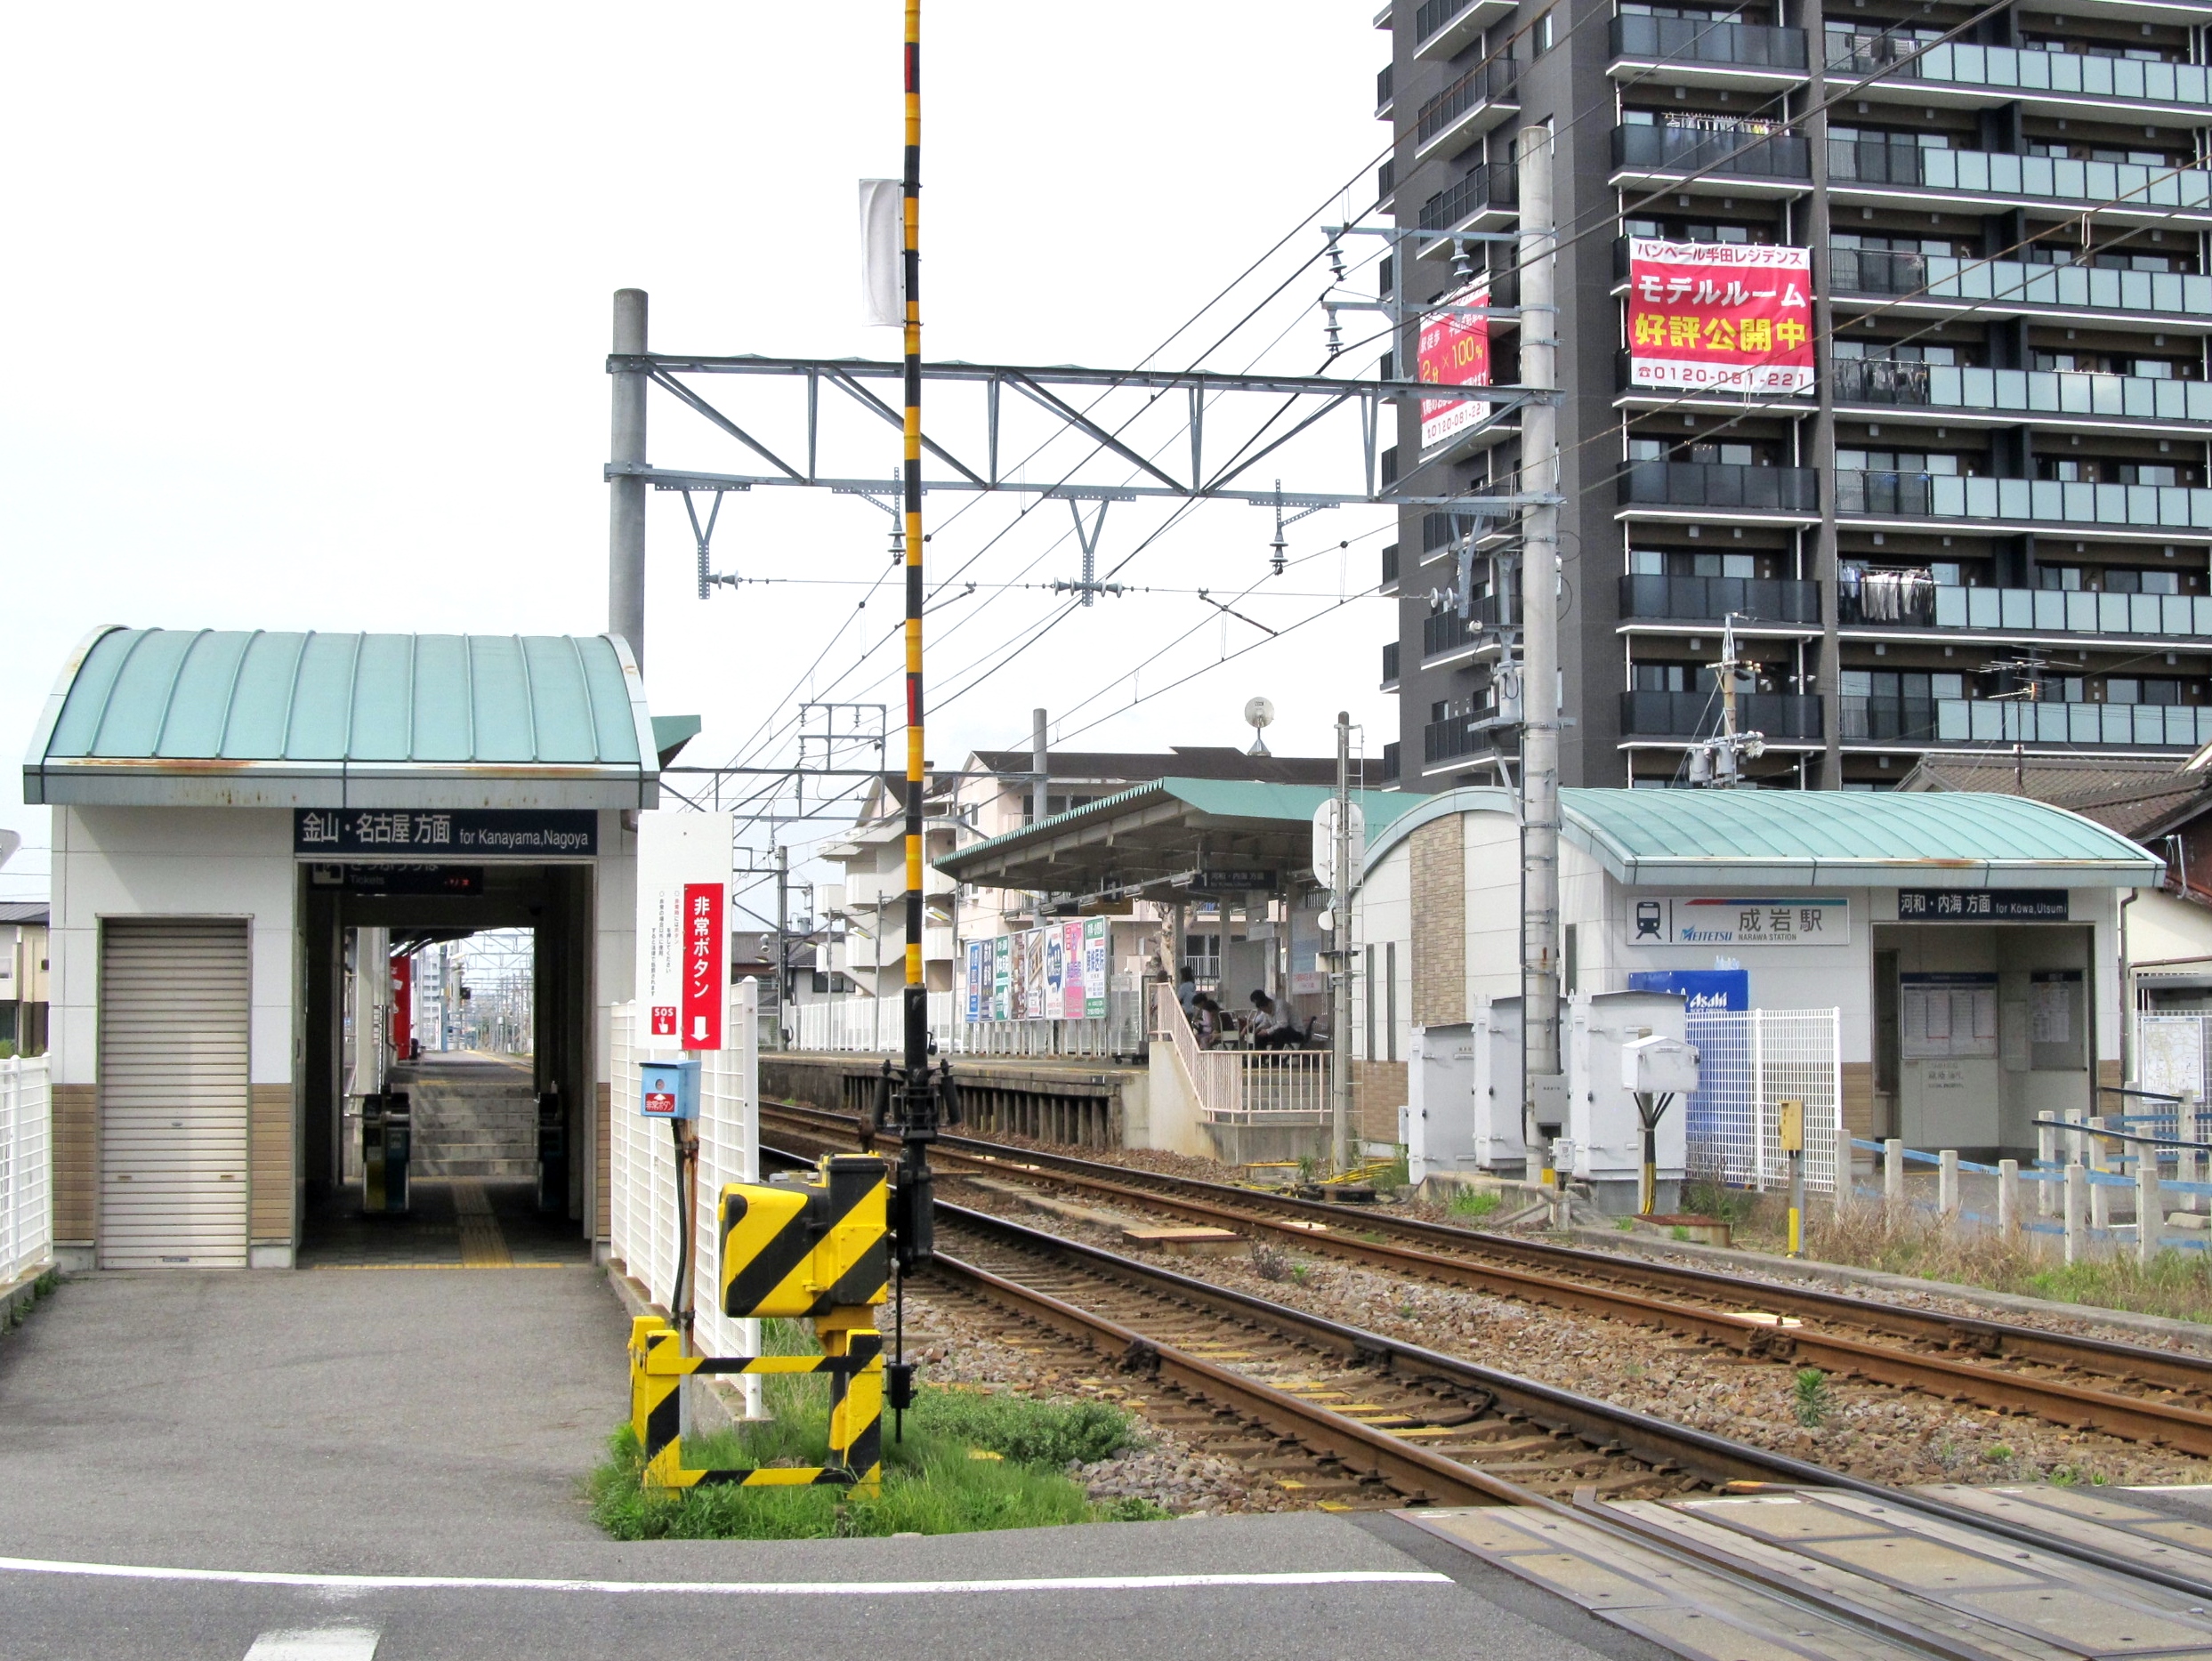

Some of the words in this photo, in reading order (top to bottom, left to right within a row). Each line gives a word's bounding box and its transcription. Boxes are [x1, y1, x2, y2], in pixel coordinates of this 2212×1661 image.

[1637, 244, 1803, 265] バンベール半田レジデンス
[1638, 274, 1806, 308] モデルルーム
[1635, 312, 1806, 352] 好評公開中
[1654, 367, 1804, 386] 0120-081-221
[459, 829, 474, 844] for
[350, 875, 385, 885] Tickets
[1996, 902, 2008, 914] for
[1739, 907, 1823, 932] 成岩駅
[1680, 924, 1732, 941] MEITETSU
[1739, 933, 1768, 941] NARAWA
[1770, 933, 1797, 941] STATION
[692, 896, 711, 998] 非常ボタン
[1690, 991, 1728, 1008] Asahi
[654, 1007, 674, 1017] SOS
